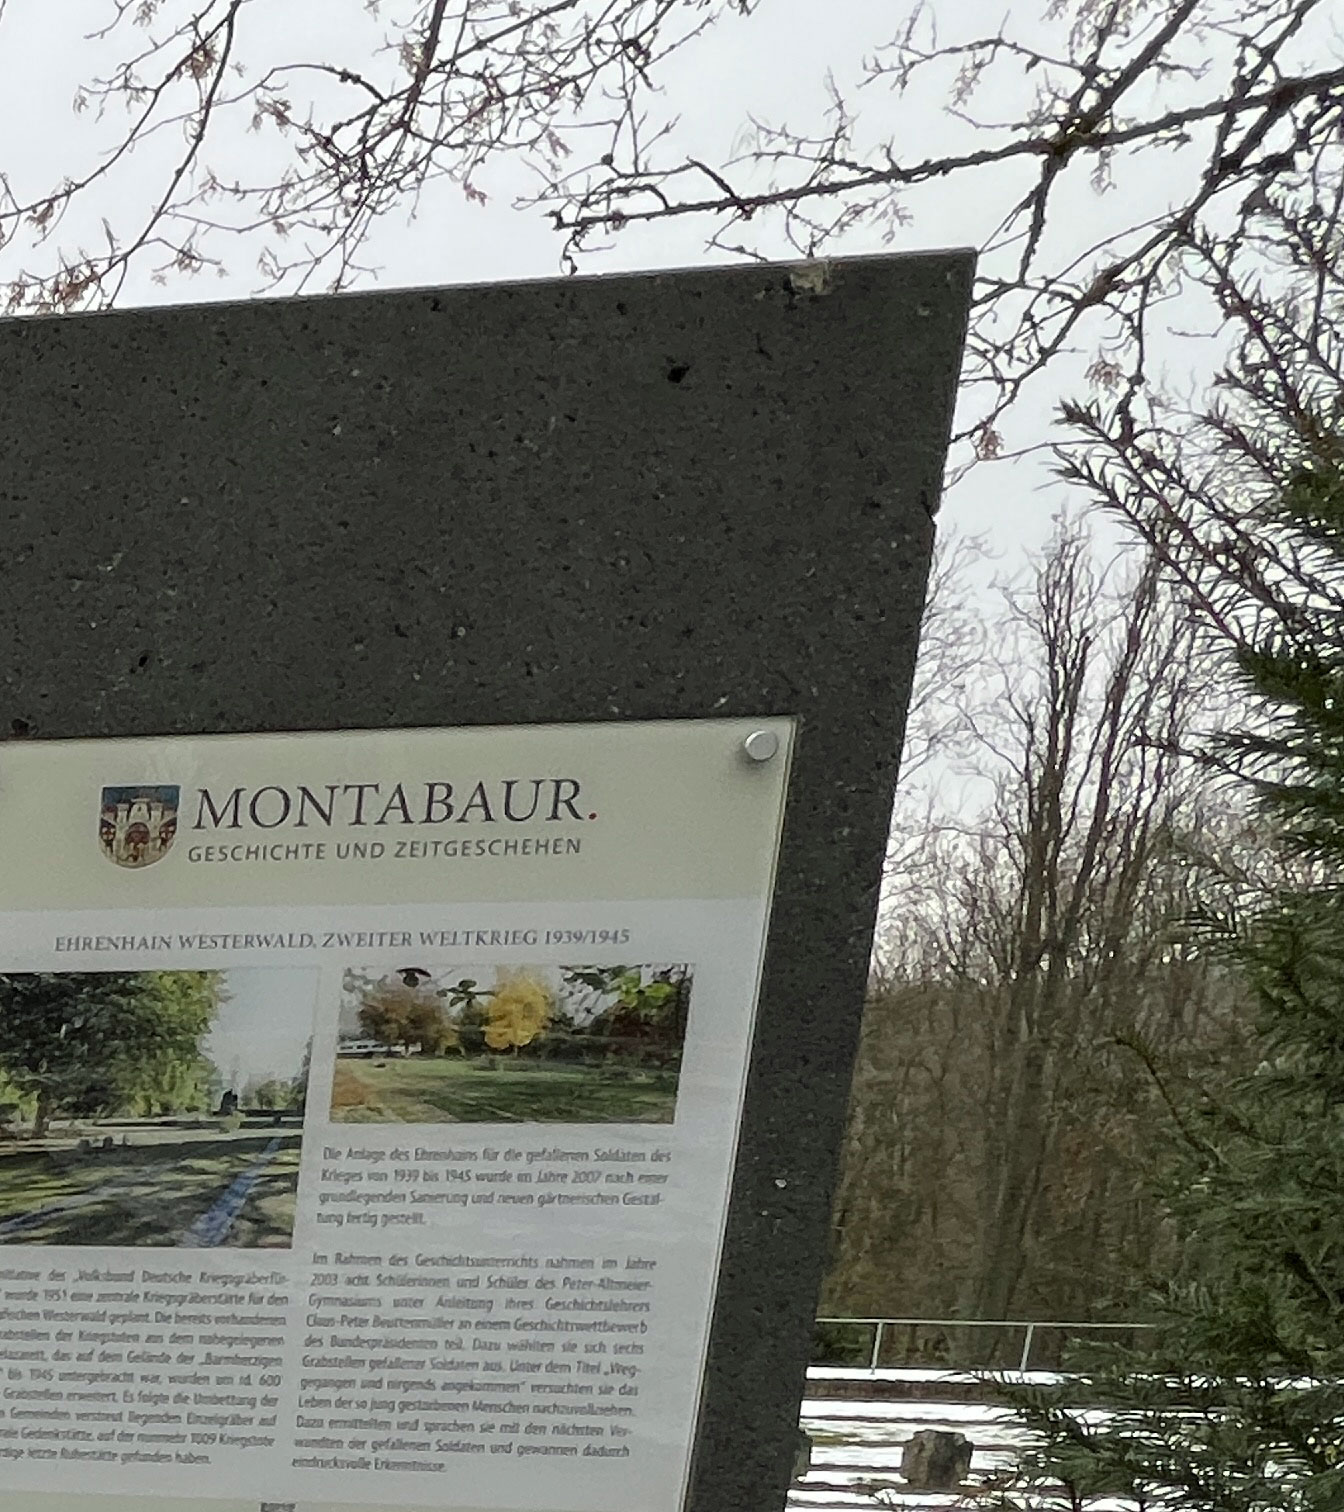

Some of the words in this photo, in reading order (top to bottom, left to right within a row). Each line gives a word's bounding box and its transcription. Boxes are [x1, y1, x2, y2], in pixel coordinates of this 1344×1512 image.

[190, 776, 602, 830] MONTABAUR.
[187, 842, 327, 862] GESCHICHTE
[334, 840, 385, 860] UND
[393, 836, 583, 858] ZEITGESCHEHEN
[53, 934, 172, 950] EHRENHAIN
[321, 931, 413, 947] ZWEITER
[418, 929, 538, 946] WELTKRIEG
[542, 928, 632, 945] 1939/1945
